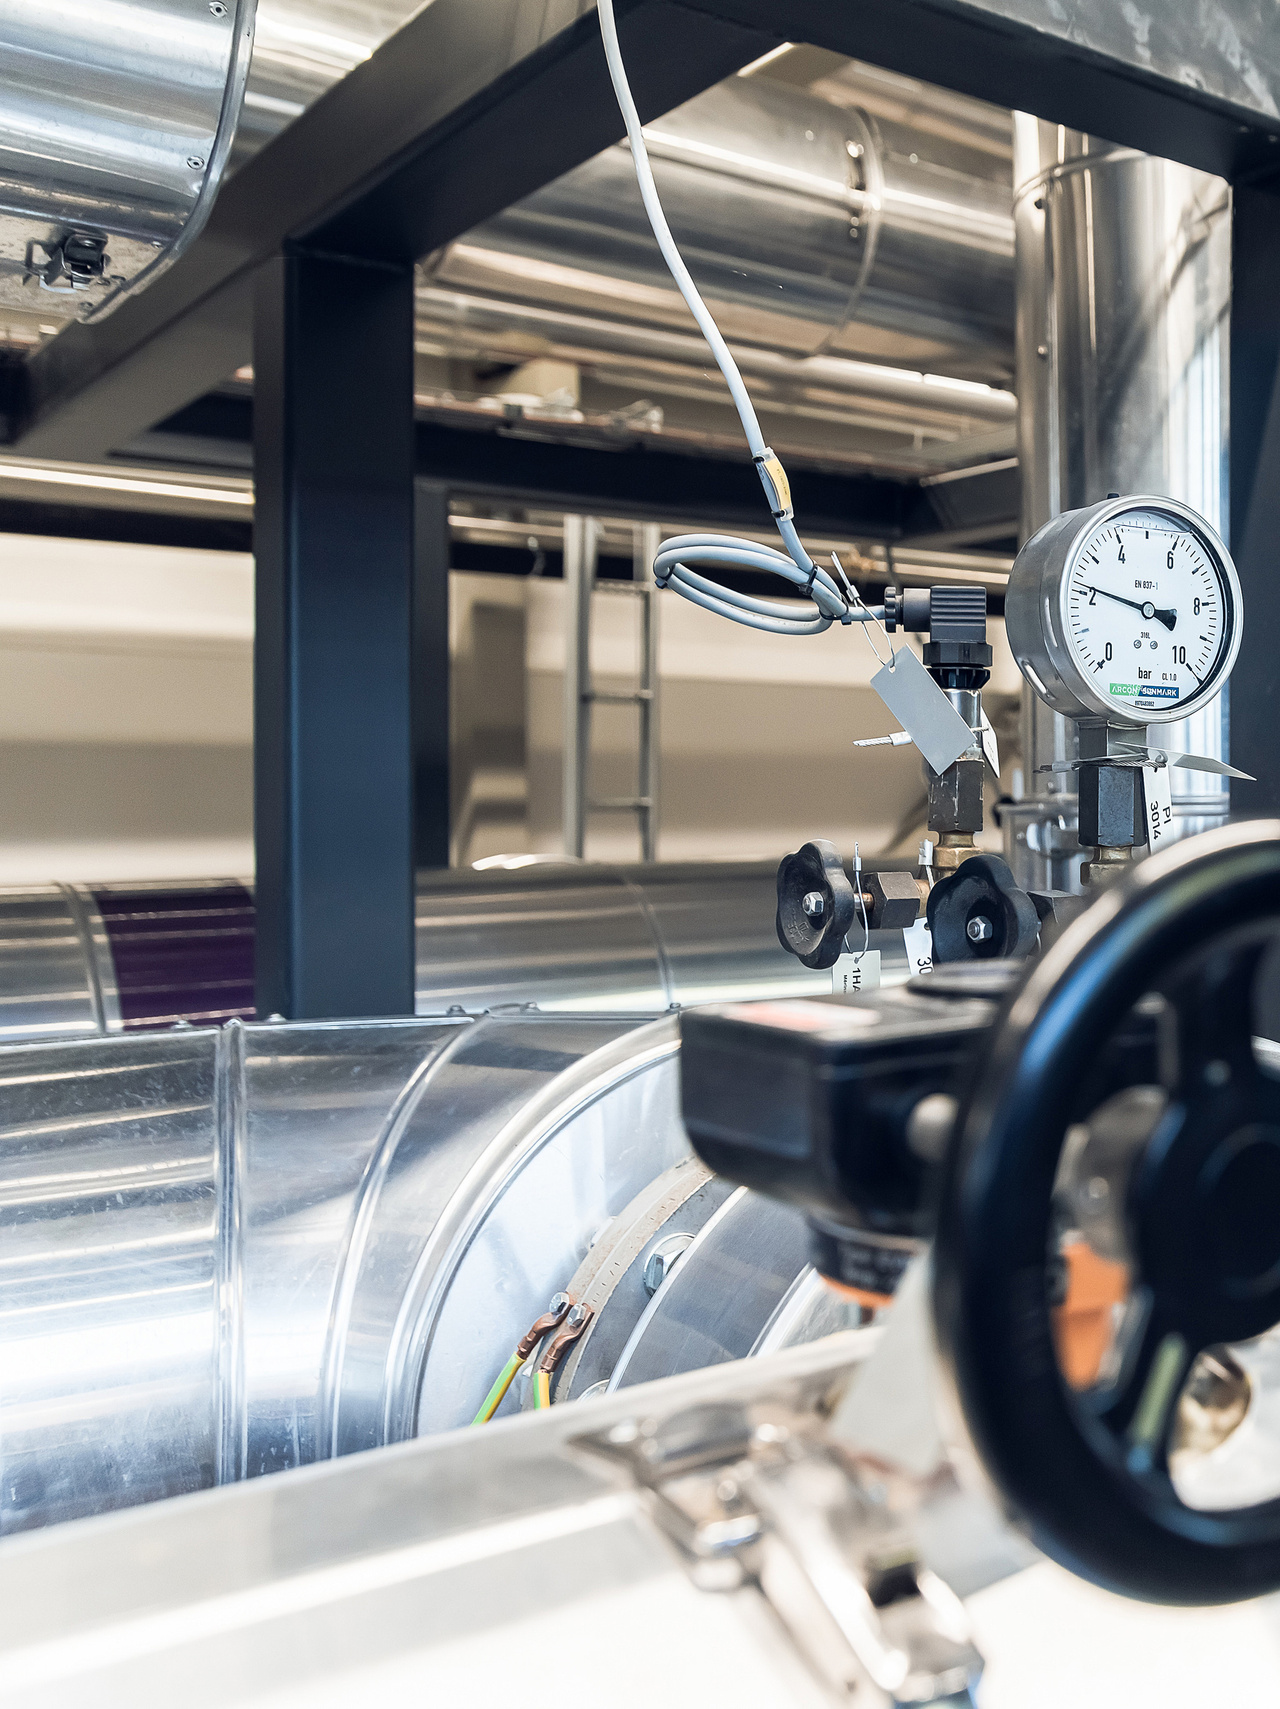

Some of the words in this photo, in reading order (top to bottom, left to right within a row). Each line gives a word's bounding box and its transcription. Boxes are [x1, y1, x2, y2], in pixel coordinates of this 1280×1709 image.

[1118, 544, 1126, 564] 4
[1167, 550, 1174, 570] 6
[1134, 580, 1142, 588] EN
[1089, 586, 1097, 606] 2
[1193, 597, 1202, 616] 8
[1105, 641, 1113, 662] 0
[1172, 645, 1186, 665] 10
[1138, 666, 1152, 680] bar
[1150, 800, 1161, 840] 3014
[1162, 806, 1172, 825] PI
